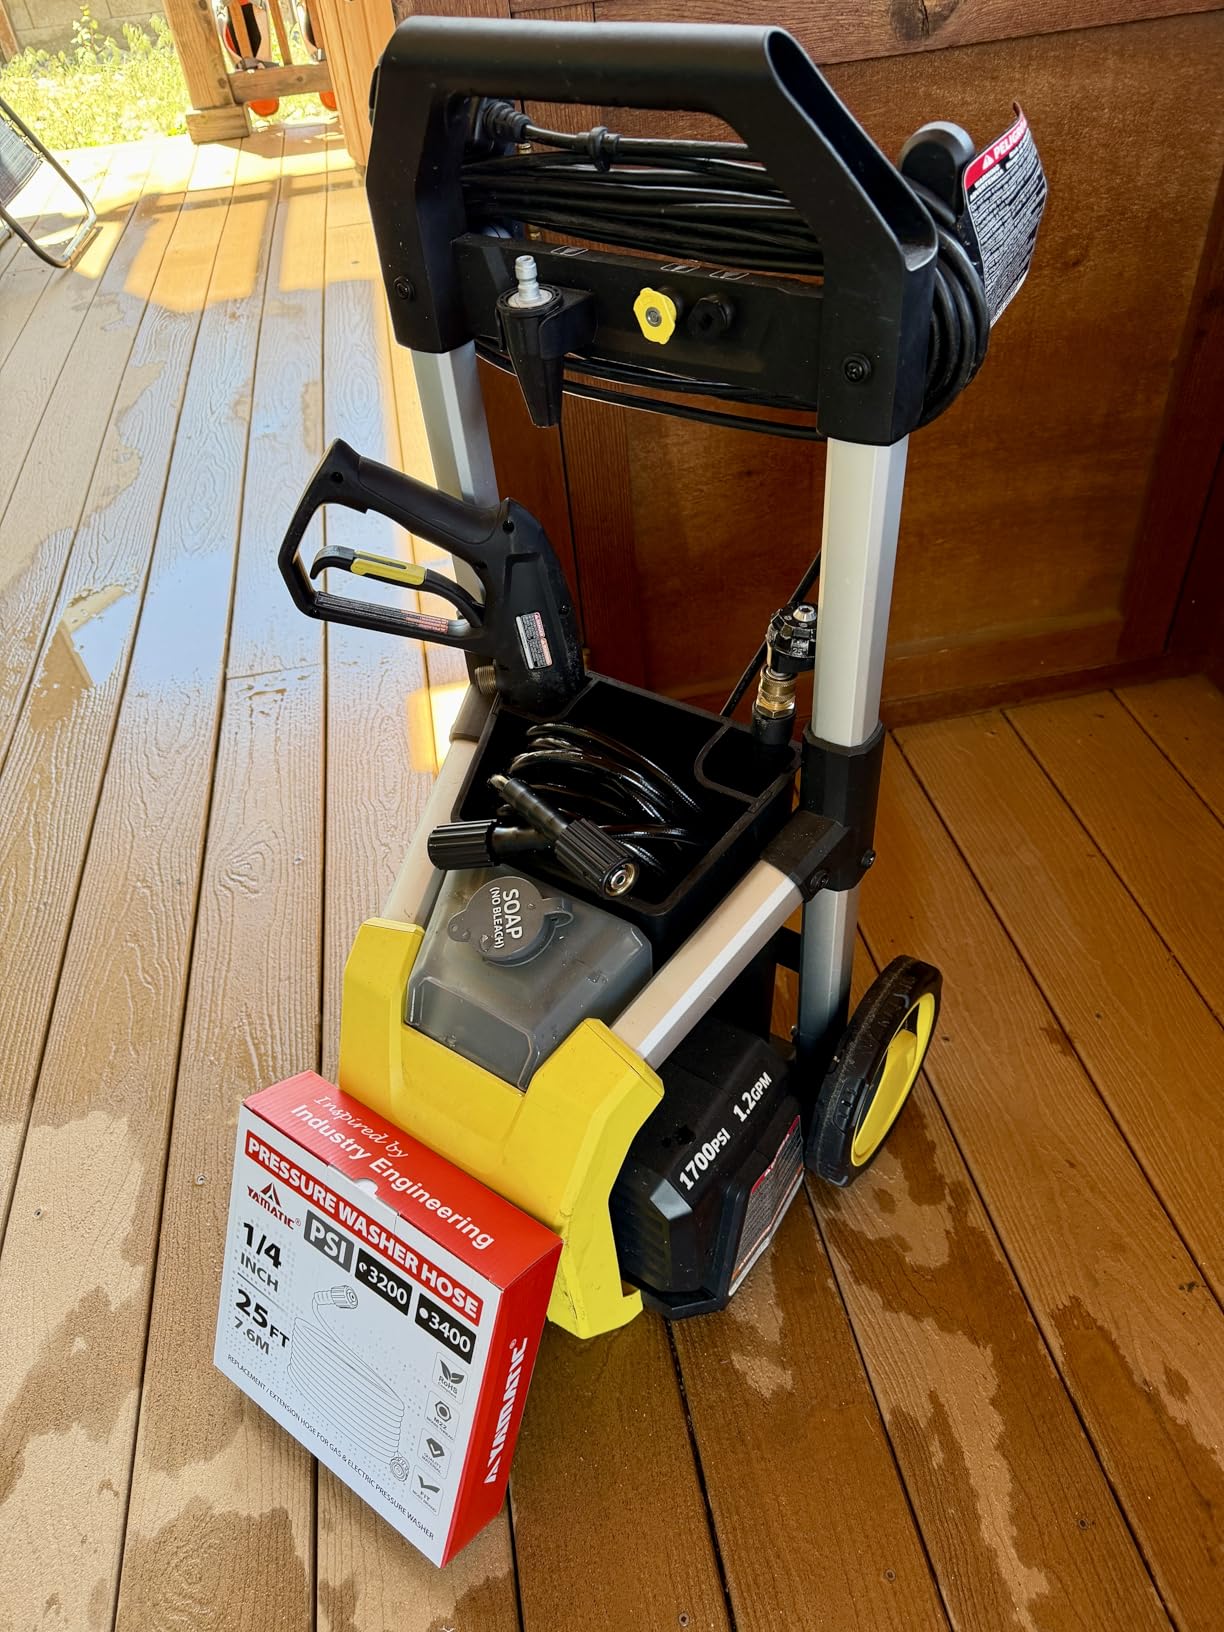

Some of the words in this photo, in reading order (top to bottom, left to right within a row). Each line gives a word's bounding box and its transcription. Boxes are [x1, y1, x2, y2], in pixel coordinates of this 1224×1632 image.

[490, 886, 501, 905] (NO
[502, 888, 523, 939] SOAP
[492, 906, 505, 949] BLEACH)
[313, 1096, 389, 1144] Inspired
[385, 1140, 408, 1158] by
[679, 1127, 731, 1190] 1700PSI
[733, 1071, 773, 1122] 1.2GPM
[291, 1104, 372, 1160] Industry
[369, 1158, 495, 1250] Engineering
[243, 1222, 282, 1270] 1/4
[248, 1137, 336, 1214] PRESSURE
[338, 1201, 419, 1275] WASHER
[420, 1260, 479, 1319] HOSE
[309, 1219, 347, 1264] PSI
[240, 1252, 279, 1293] INCH
[367, 1267, 407, 1305] 3200
[234, 1315, 270, 1355] 7.6M
[235, 1288, 268, 1329] 25
[269, 1323, 290, 1348] FT
[428, 1312, 471, 1353] 3400
[438, 1375, 458, 1394] RoHS
[227, 1353, 266, 1390] REPLACEMENT
[269, 1391, 300, 1421] EXTENSION
[300, 1418, 316, 1435] HOSE
[317, 1431, 329, 1447] FOR
[329, 1443, 342, 1457] GAS
[342, 1454, 347, 1462] &
[347, 1458, 375, 1488] ELECTRIC
[375, 1484, 407, 1515] PRESSURE
[407, 1512, 434, 1540] WASHER
